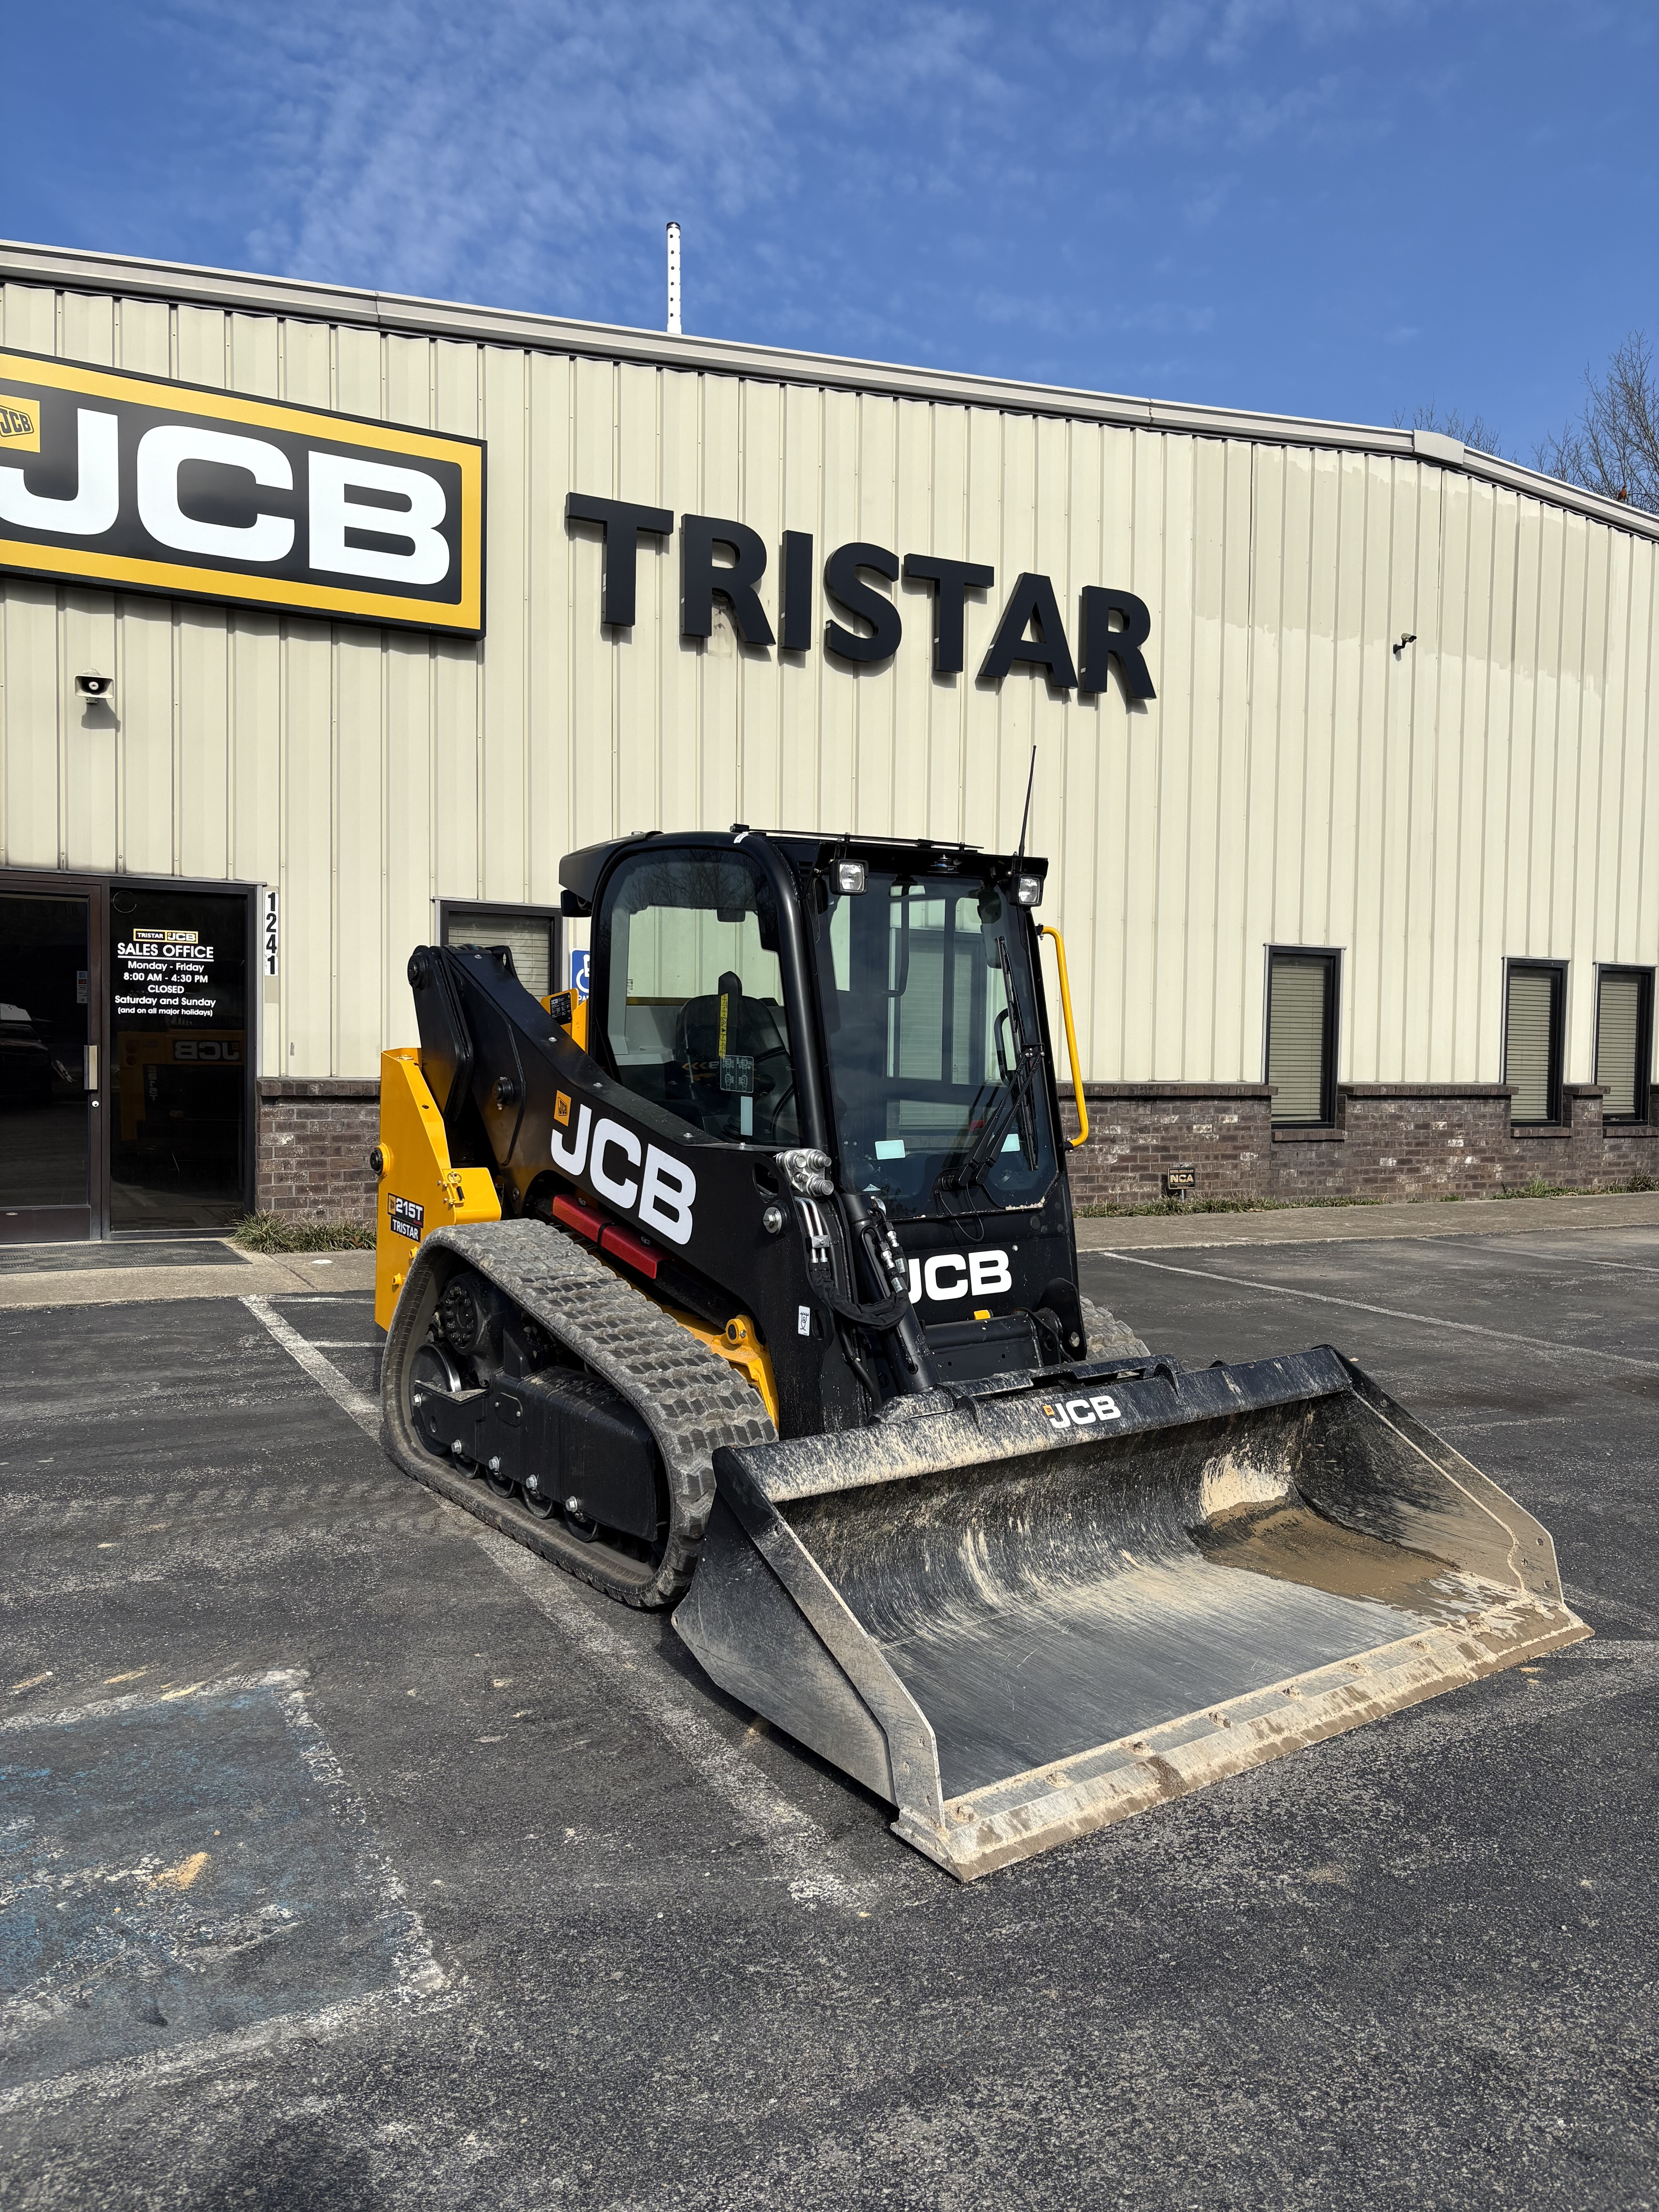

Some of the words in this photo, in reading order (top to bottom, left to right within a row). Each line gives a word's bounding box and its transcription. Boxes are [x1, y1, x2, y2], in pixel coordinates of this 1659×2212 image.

[0, 408, 31, 434] JCB
[0, 408, 450, 584] JCB
[566, 492, 1157, 699] TRISTAR
[167, 933, 196, 941] JCB
[266, 892, 277, 975] 1241
[117, 942, 158, 956] SALES
[163, 945, 213, 958] OFFICE
[124, 972, 145, 981] 8:00
[171, 974, 192, 982] 4:30
[128, 961, 167, 971] Monday
[176, 963, 204, 972] Friday
[148, 985, 184, 993] CLOSED
[115, 995, 157, 1006] Saturday
[181, 997, 216, 1008] Sunday
[181, 1009, 213, 1017] holidays)
[551, 1104, 696, 1245] JCB
[1170, 1174, 1194, 1183] NCA
[396, 1198, 423, 1221] 215T
[392, 1219, 419, 1240] TRISTAR
[908, 1250, 1012, 1304] JCB
[1049, 1395, 1121, 1429] JCB
